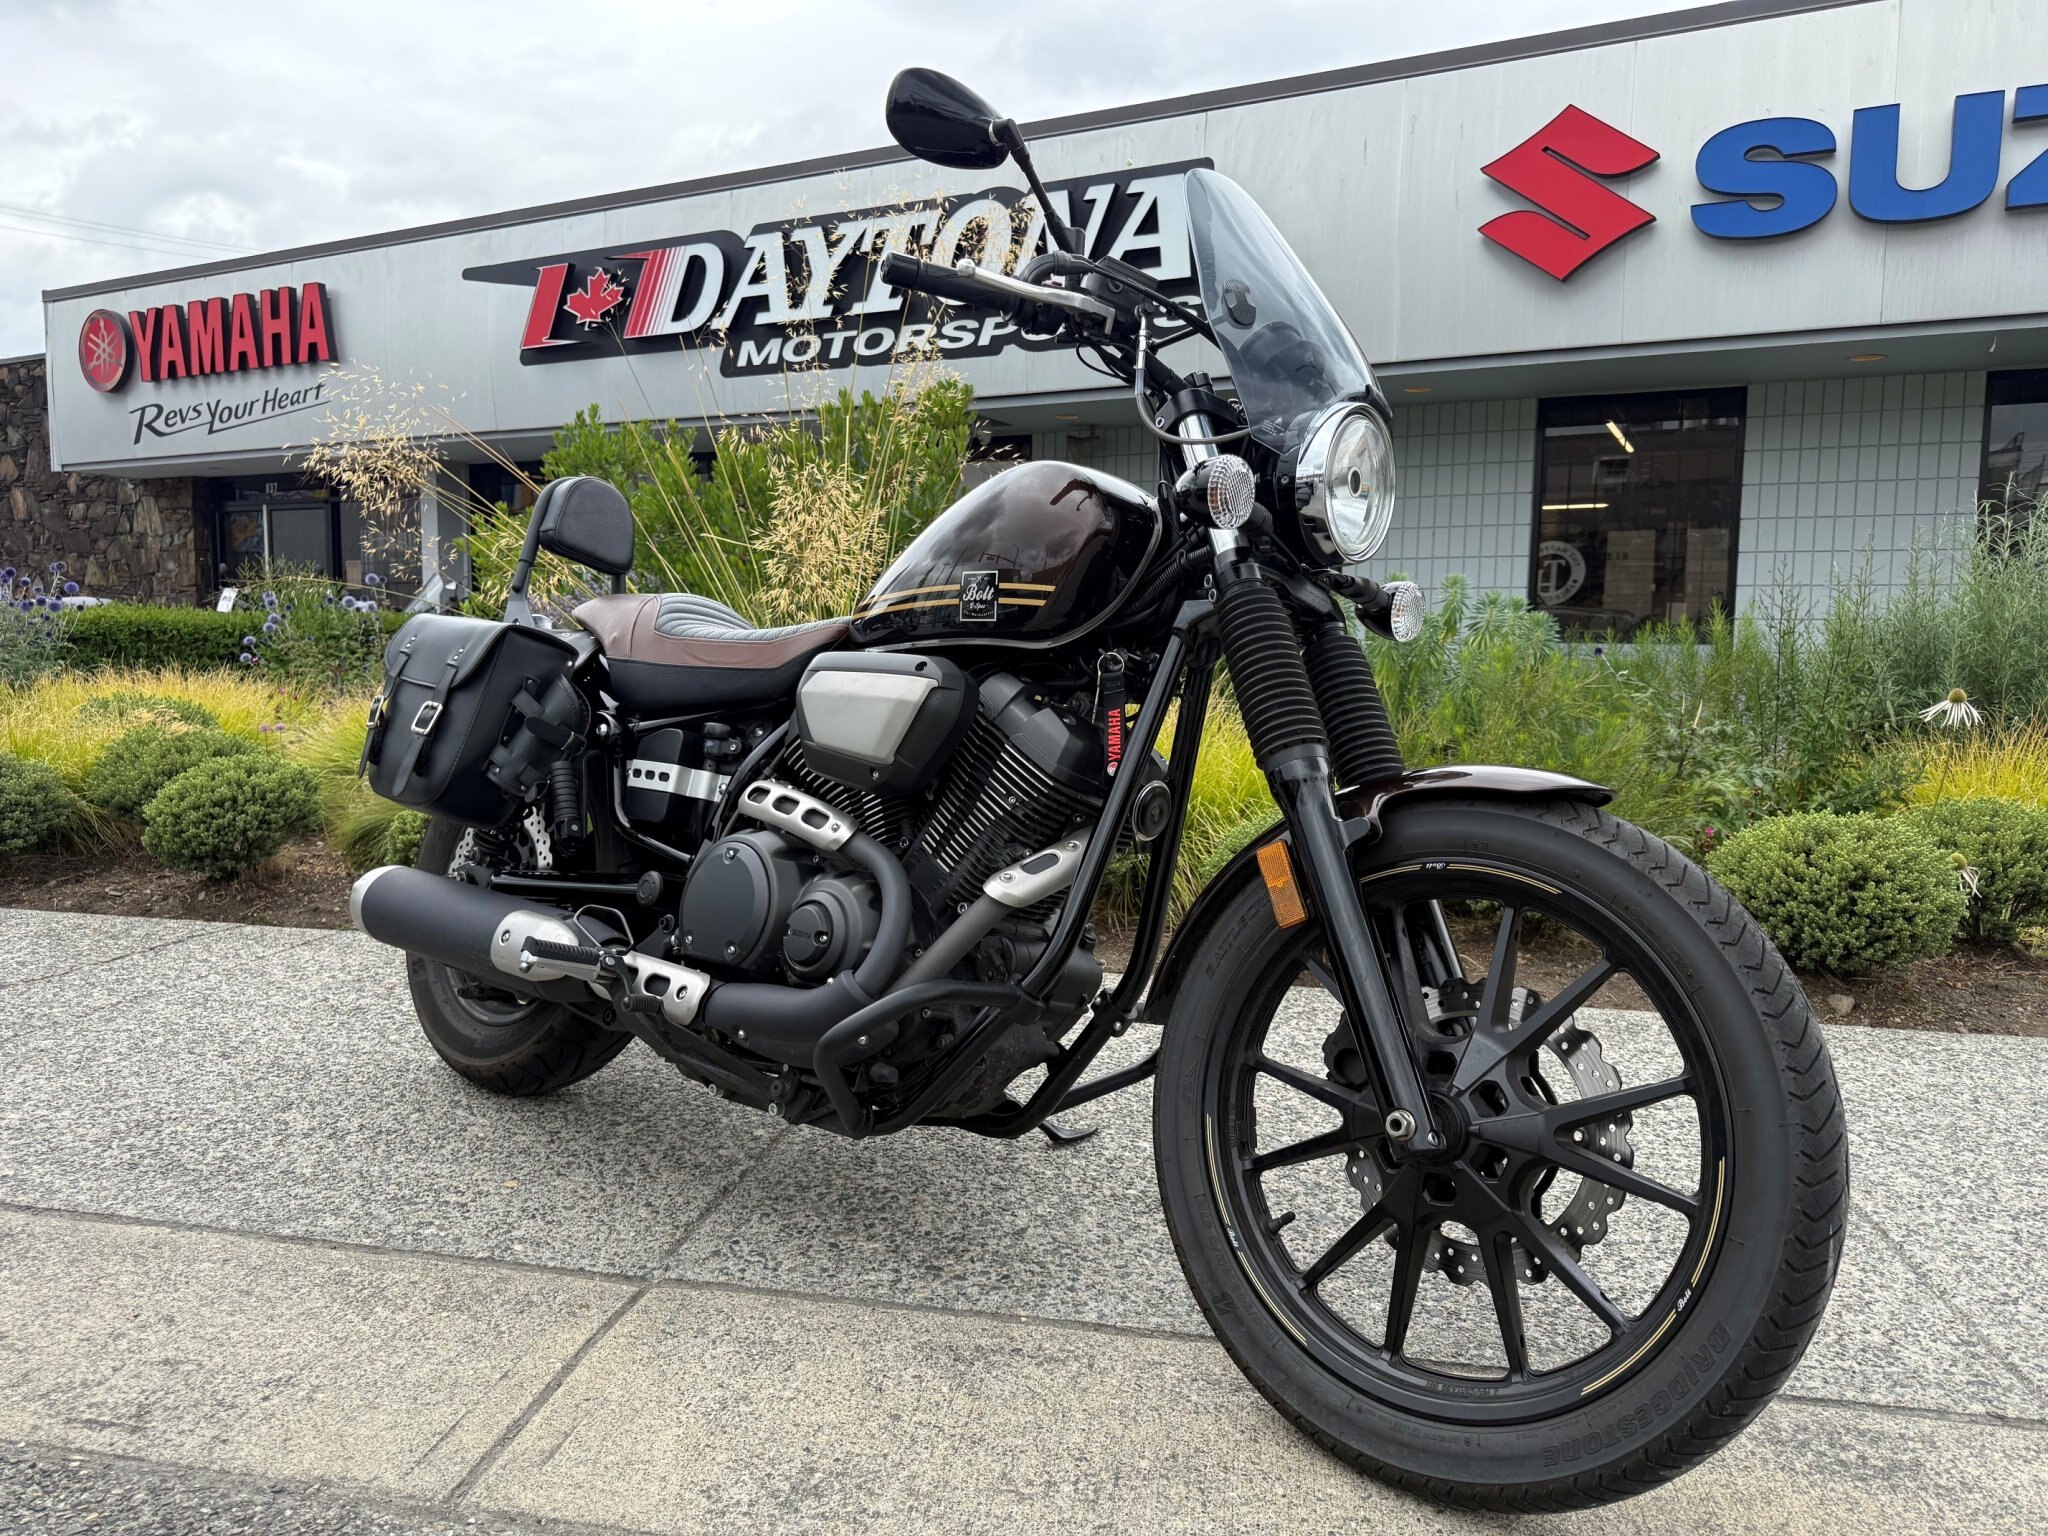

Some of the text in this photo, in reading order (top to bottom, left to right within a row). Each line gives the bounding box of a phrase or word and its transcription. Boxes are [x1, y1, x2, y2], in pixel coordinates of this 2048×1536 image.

[612, 172, 1193, 338] DAYTONA
[129, 281, 336, 382] YAMAHA
[129, 382, 325, 445] Revs Your Heart
[963, 583, 994, 600] Bolt
[1107, 708, 1121, 762] YAMAHA
[1677, 1288, 1692, 1312] Bolt
[1543, 1320, 1733, 1468] BRIDGESTONE
